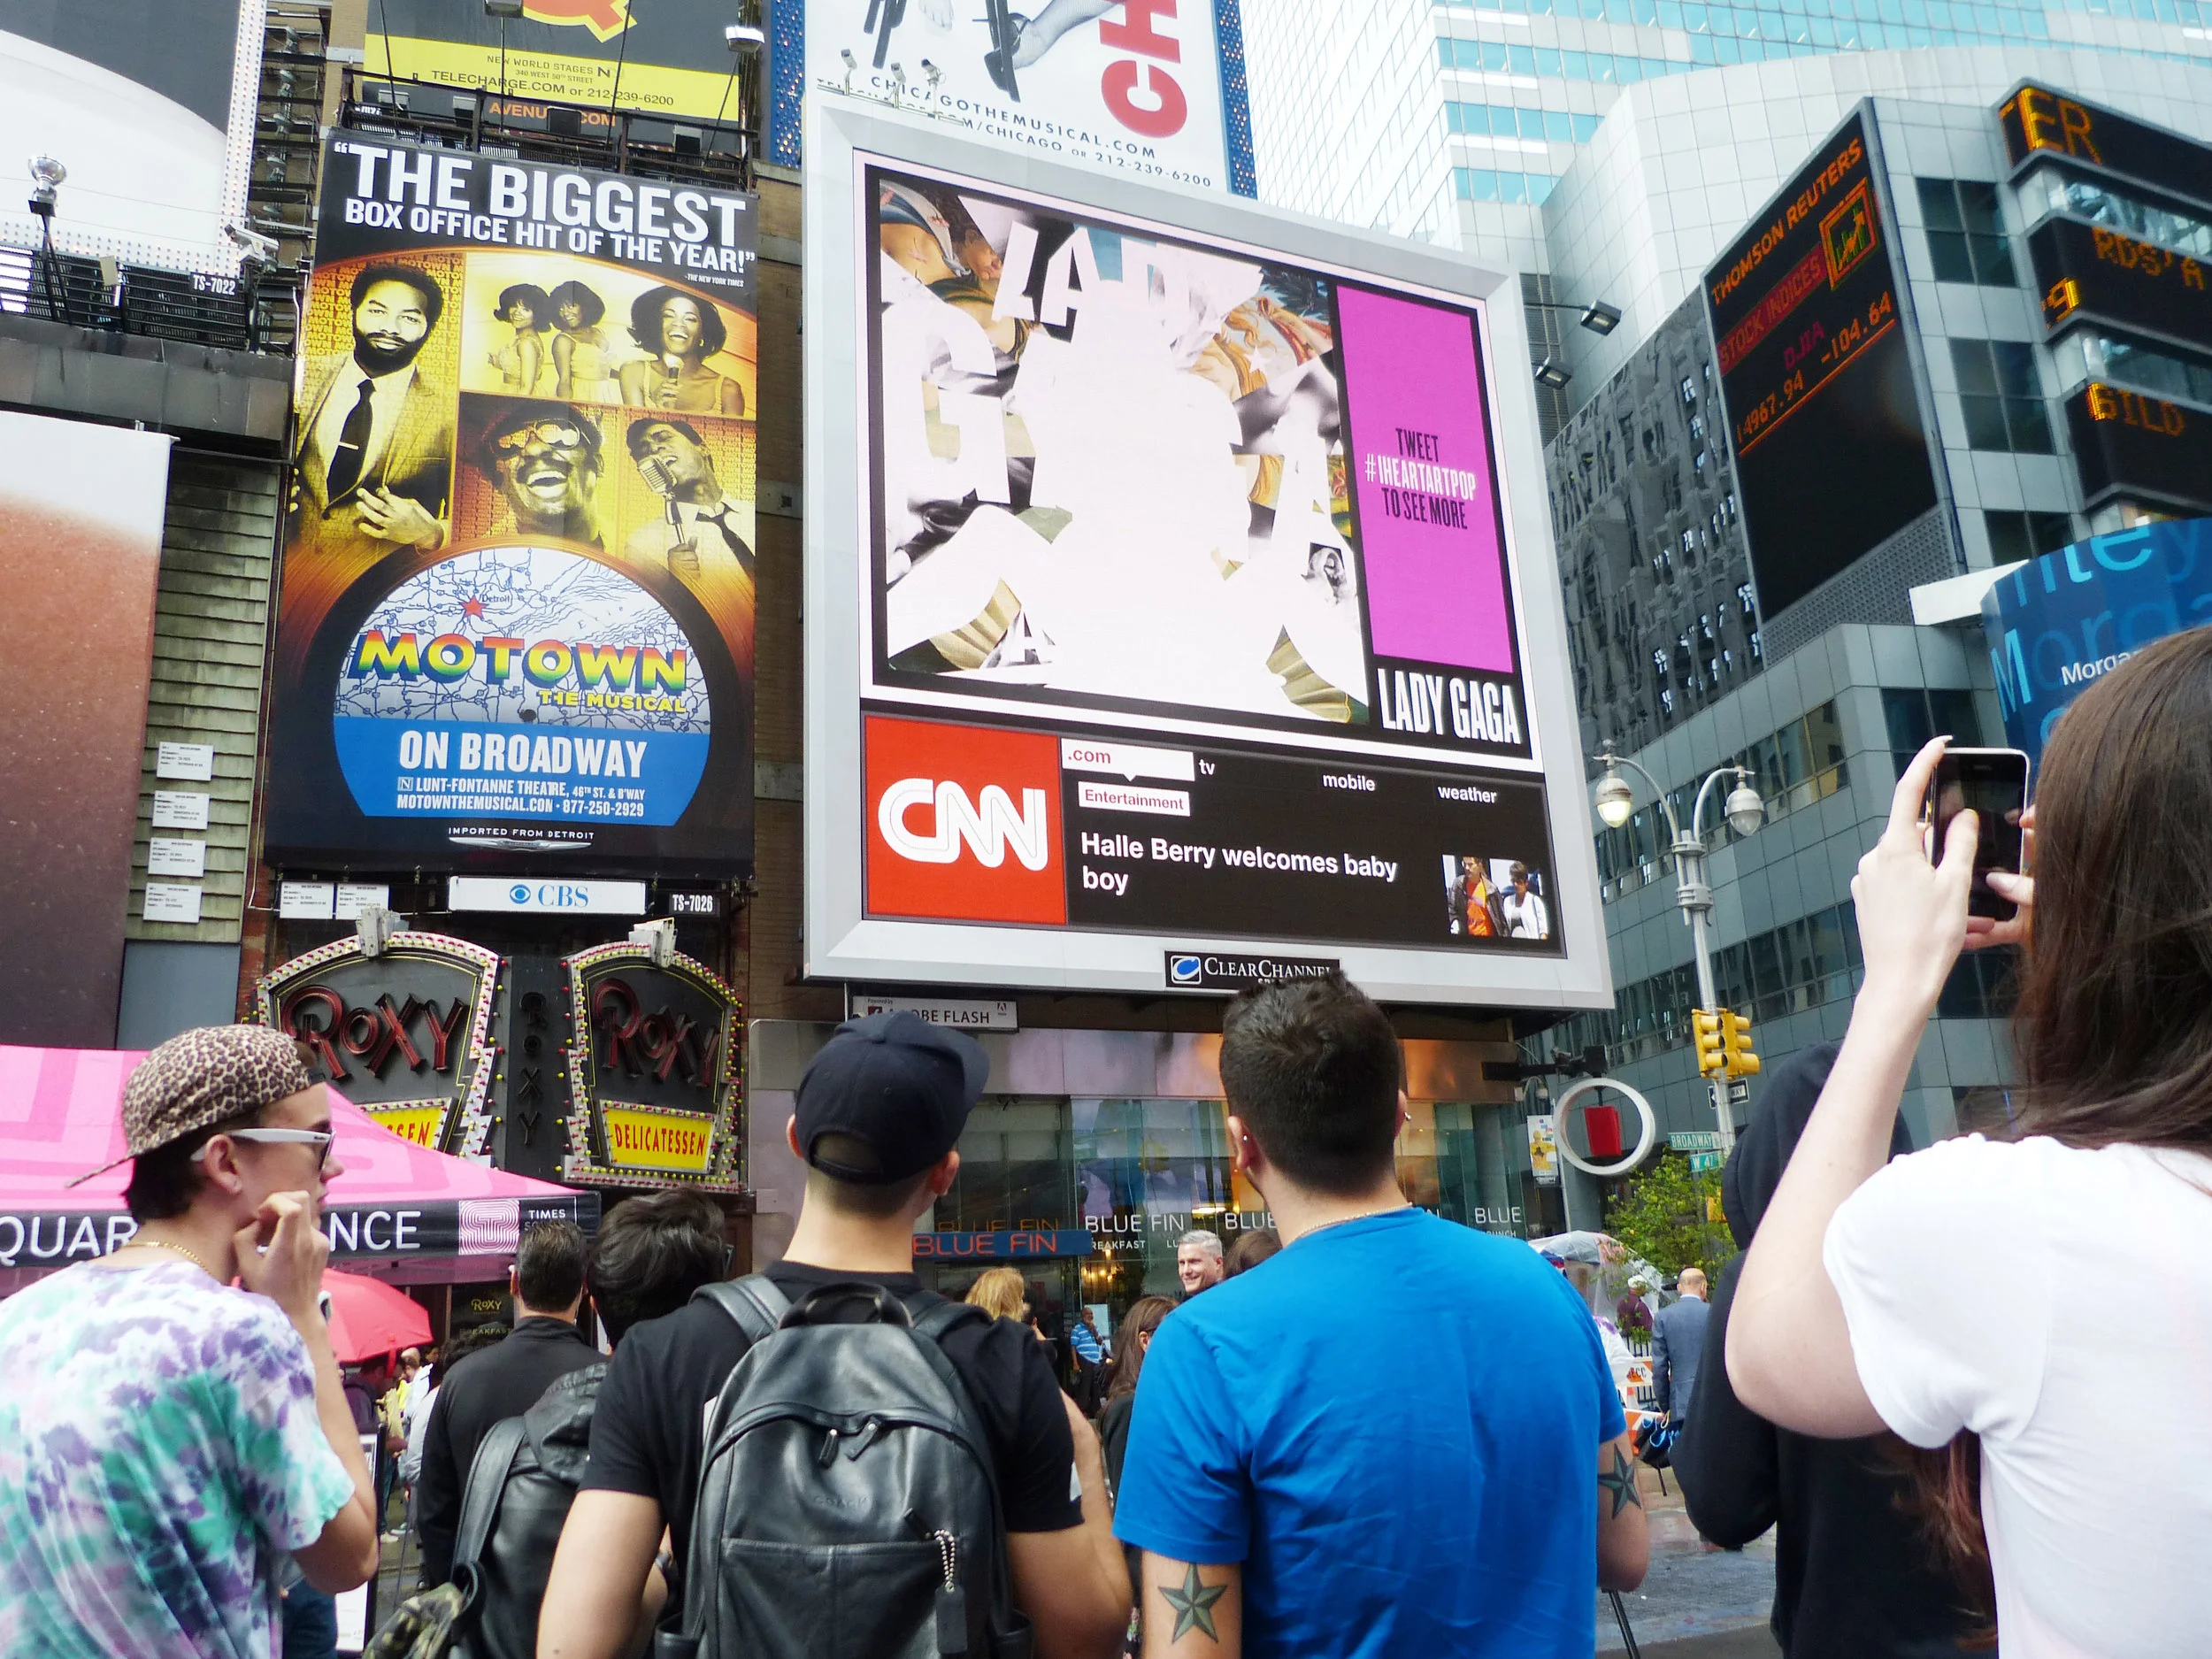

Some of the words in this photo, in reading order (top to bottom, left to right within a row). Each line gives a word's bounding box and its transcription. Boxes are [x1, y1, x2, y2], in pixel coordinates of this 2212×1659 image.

[487, 55, 510, 65] NEW
[514, 58, 550, 70] WORLD
[554, 63, 594, 74] STAGES
[431, 70, 565, 94] TELECHARGE.COM
[570, 88, 583, 97] or
[588, 88, 674, 106] 212-239-6200
[567, 75, 594, 84] STREET
[489, 102, 617, 127] AVENUCOM
[1095, 151, 1212, 188] 212-239-6200
[489, 165, 746, 246] BIGGEST
[345, 198, 403, 230] BOX
[411, 206, 508, 243] OFFICE
[515, 220, 562, 250] HIT
[569, 227, 604, 254] OF
[611, 232, 663, 265] THE
[1711, 219, 1785, 305] THOMSON
[1786, 137, 1863, 230] REUTERS
[193, 274, 236, 296] TS-7022
[1720, 310, 1764, 368] STOCK
[1768, 255, 1821, 323] INDICES
[1736, 369, 1804, 443] 14967.94
[1821, 290, 1892, 364] -104.64
[1395, 427, 1439, 462] TWEET
[1364, 453, 1476, 502] #IHEARTARTPOP
[1381, 488, 1401, 518] TO
[1402, 491, 1427, 523] SEE
[1429, 495, 1468, 530] MORE
[482, 594, 511, 603] Detroit
[348, 630, 687, 695] MOTOWN
[537, 689, 579, 707] THE
[586, 693, 687, 713] MUSICAL
[1377, 668, 1444, 735] LADY
[1448, 677, 1522, 745] GAGA
[399, 730, 449, 771] ON
[460, 733, 647, 779] BROADWAY
[1068, 749, 1111, 764] .com
[1199, 758, 1216, 775] tv
[1322, 772, 1376, 792] mobile
[1437, 786, 1497, 803] weather
[416, 777, 513, 794] LUNT-FONTANNE
[593, 787, 606, 798] ST.
[608, 787, 616, 799] &
[618, 787, 645, 801] B'WAY
[1085, 788, 1184, 810] Entertainment
[563, 799, 644, 818] 877-250-2929
[449, 827, 508, 836] IMPORTED
[512, 828, 543, 837] FROM
[548, 830, 594, 840] DETROIT
[878, 778, 1048, 872] CNN
[1081, 832, 1144, 859] Halle
[1150, 837, 1216, 870] Berry
[1222, 845, 1340, 875] welcomes
[1344, 853, 1398, 883] baby
[1081, 864, 1129, 896] boy
[538, 884, 589, 907] CBS
[672, 894, 714, 913] TS-7026
[944, 1010, 990, 1024] FLASH
[280, 984, 472, 1080] ROXY
[592, 978, 721, 1087] ROXY
[614, 1124, 706, 1157] DELICATESSEN
[1671, 1133, 1713, 1148] BROADWAY
[1692, 1156, 1701, 1170] W
[1704, 1155, 1714, 1167] 47
[528, 1209, 566, 1219] TIMES
[1085, 1213, 1142, 1233] BLUE
[1151, 1212, 1184, 1232] FIN
[1225, 1212, 1278, 1230] BLUE
[1475, 1207, 1522, 1224] BLUE
[912, 1233, 995, 1256] BLUE
[1010, 1231, 1057, 1254] FIN
[1091, 1239, 1146, 1250] REAKFAST
[471, 1299, 502, 1310] ROXY
